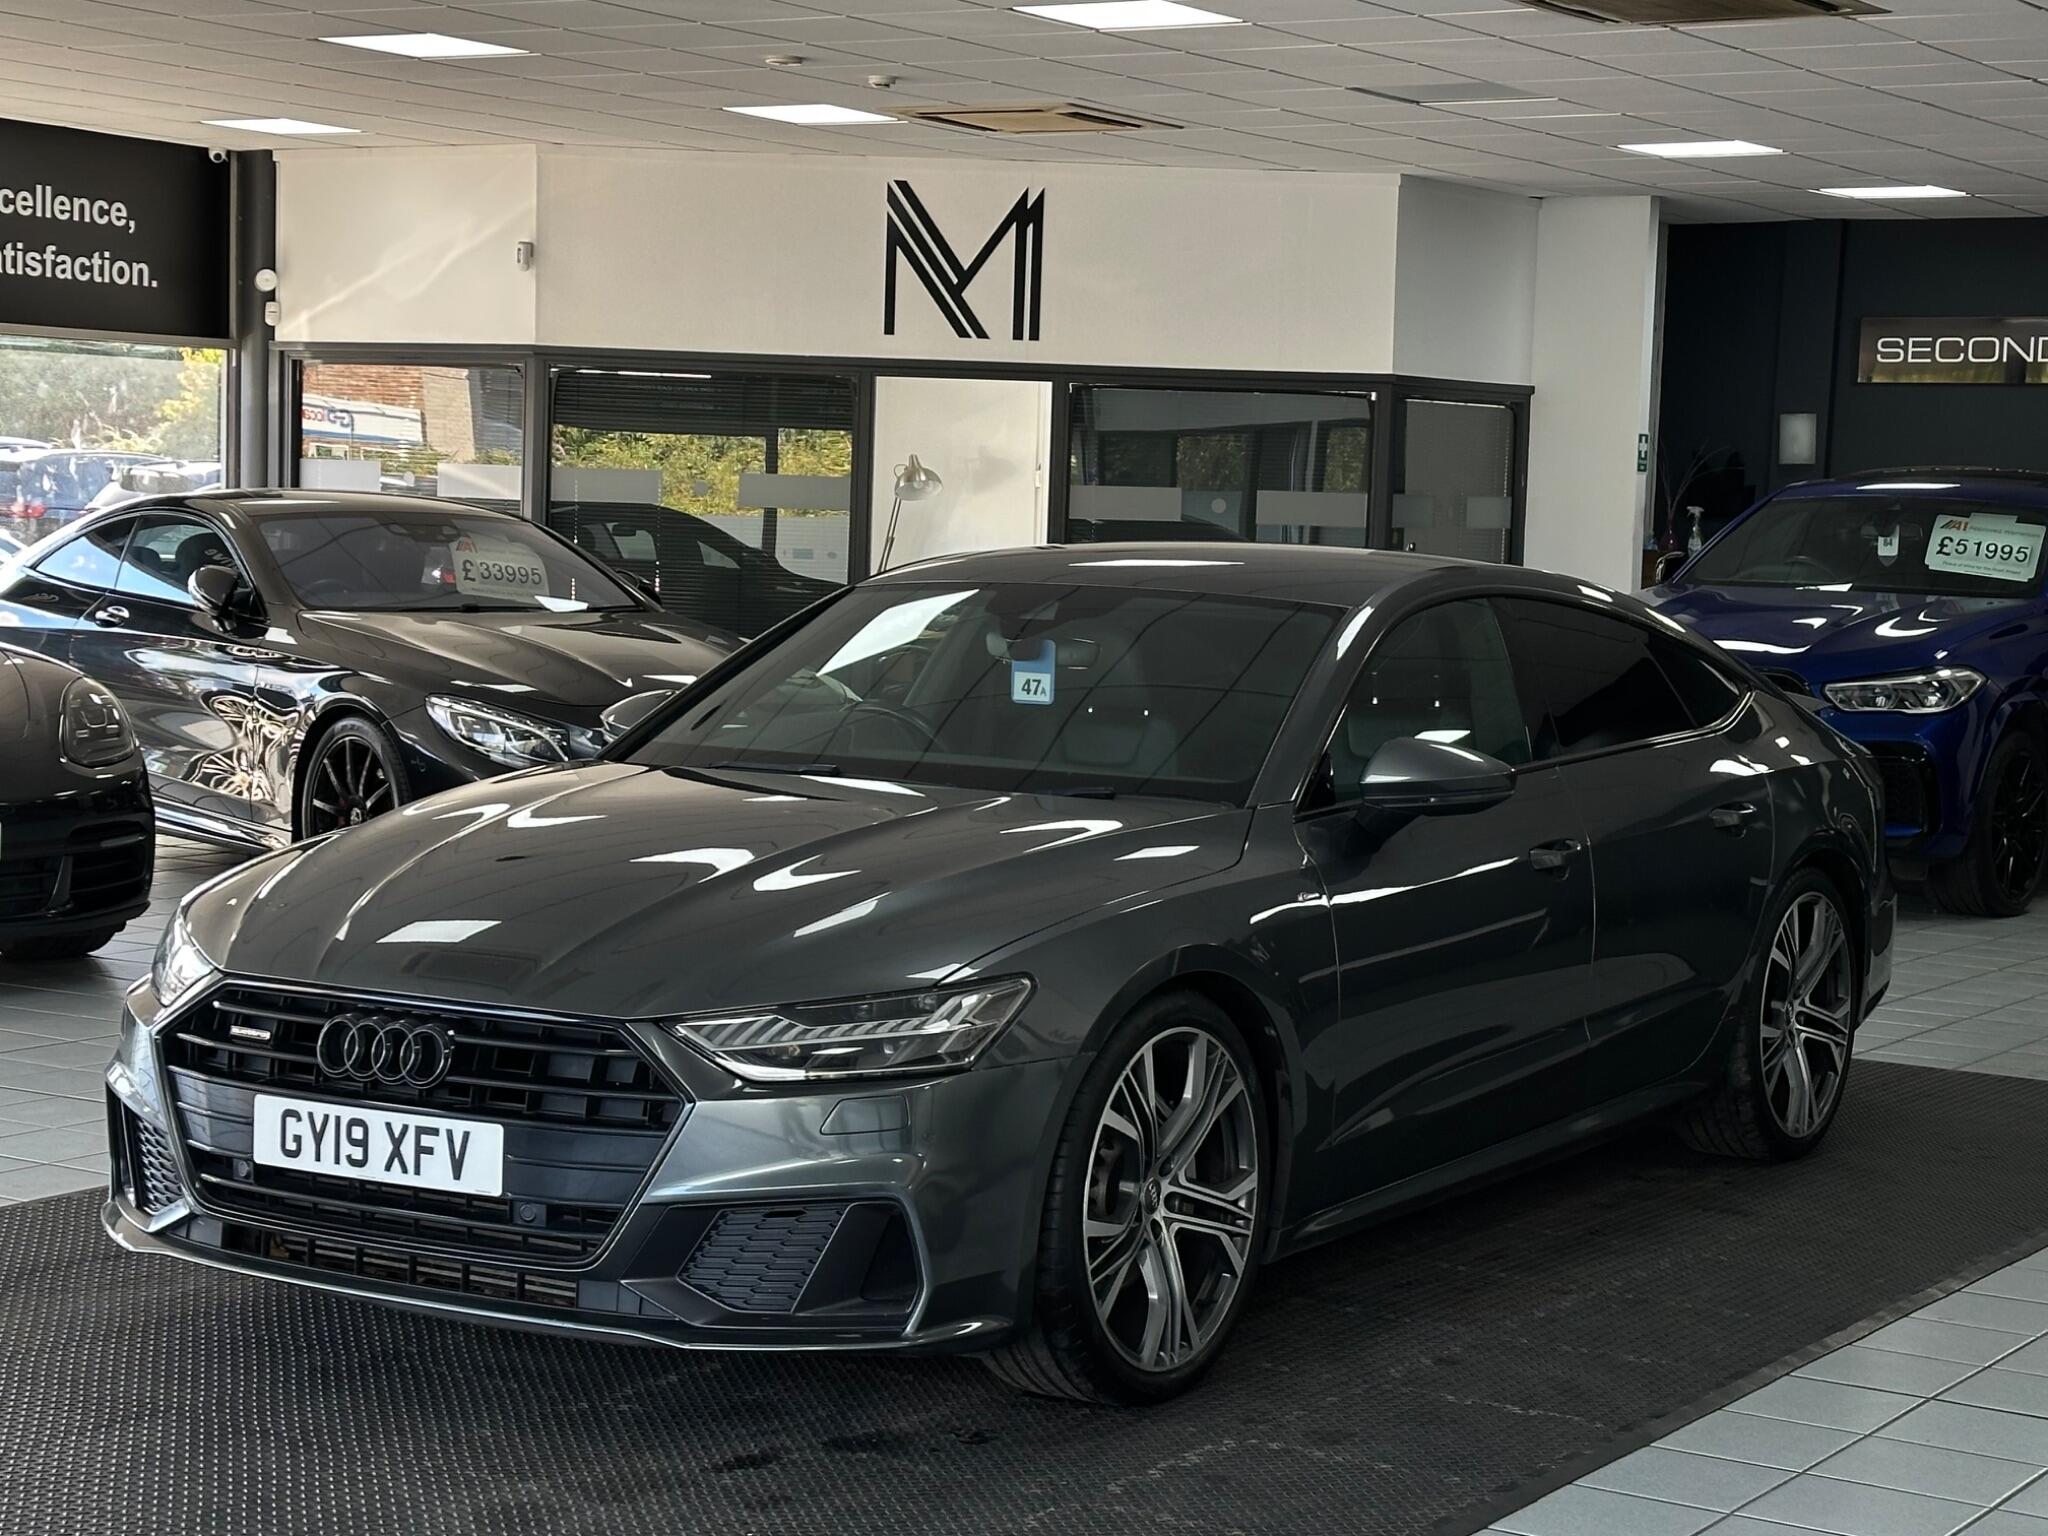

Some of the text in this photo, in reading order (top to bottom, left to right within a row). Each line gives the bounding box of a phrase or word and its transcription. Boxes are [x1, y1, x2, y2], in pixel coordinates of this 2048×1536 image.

[0, 184, 136, 234] cellence,
[0, 242, 158, 288] tisfaction.
[462, 559, 542, 585] £33995
[1936, 536, 2030, 563] £51995
[280, 1107, 471, 1181] GY19 XFV
